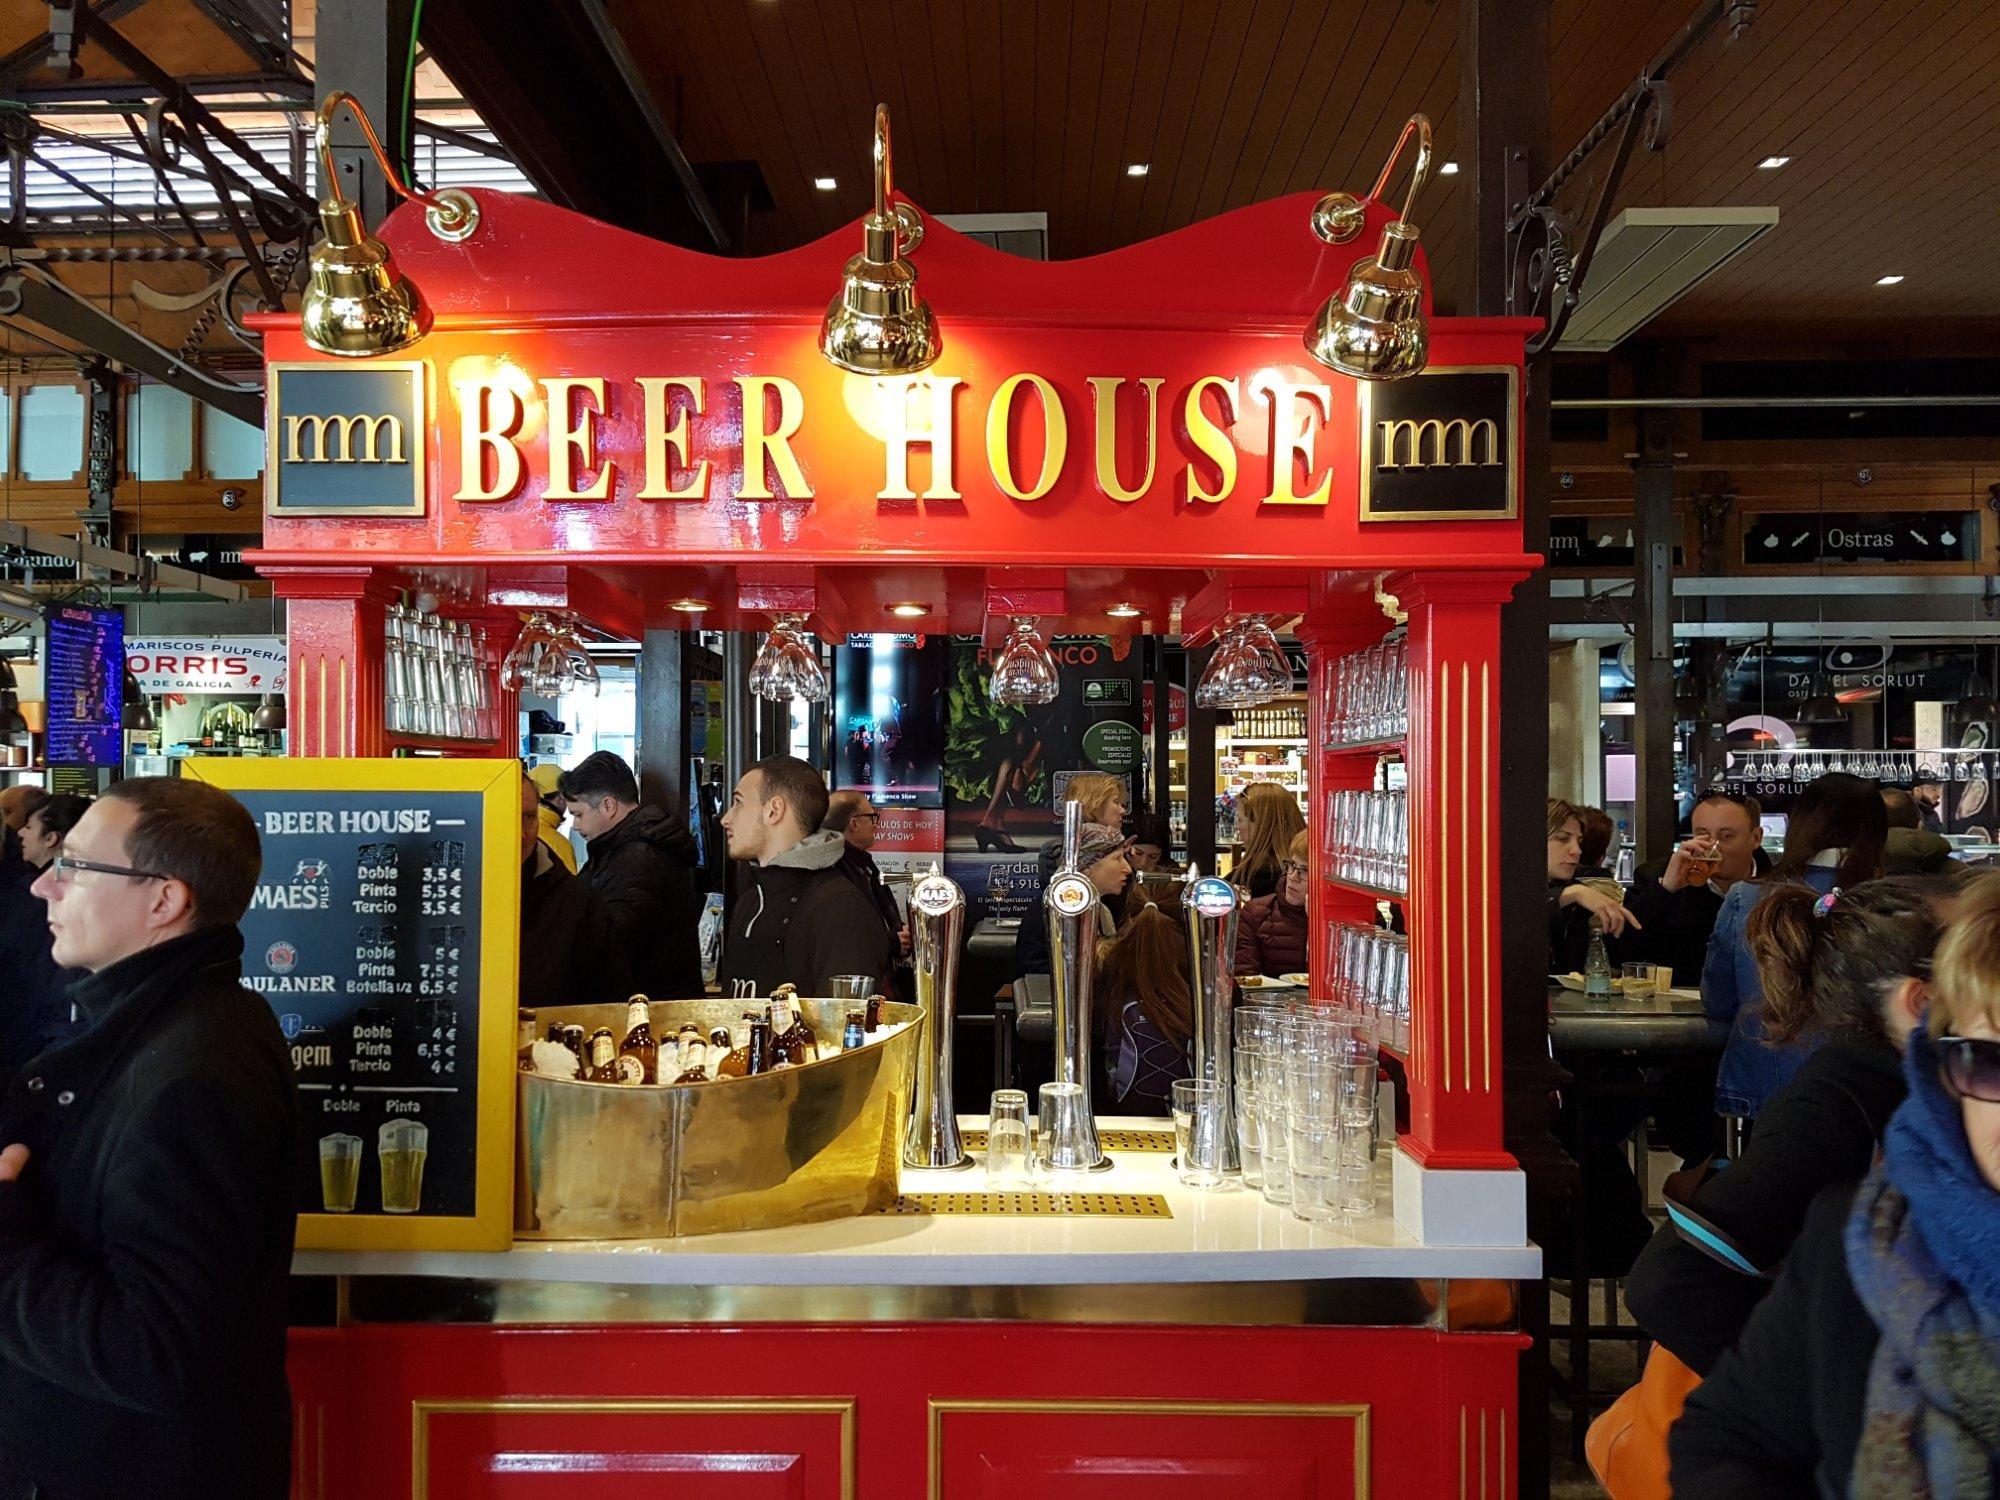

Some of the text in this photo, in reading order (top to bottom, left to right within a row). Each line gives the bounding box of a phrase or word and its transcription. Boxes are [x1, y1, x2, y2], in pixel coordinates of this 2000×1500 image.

[453, 372, 1334, 505] BEER HOUSE
[1828, 528, 1894, 548] Ostras
[977, 646, 1098, 666] FLNCO
[153, 679, 170, 687] DE
[176, 680, 232, 688] GALICIA
[1789, 674, 1926, 687] DAEL SORLUT
[1756, 783, 1809, 795] SORLU
[264, 809, 431, 835] BEER HOUSE
[903, 820, 914, 828] DE
[915, 821, 933, 829] HOY
[886, 832, 915, 840] SHOWS
[357, 866, 398, 880] Doble
[422, 867, 447, 882] 3,5
[250, 885, 318, 910] MAES
[320, 885, 330, 909] PILS
[359, 883, 397, 897] Pinta
[421, 885, 447, 899] 5,5
[352, 901, 397, 914] Tercio
[421, 901, 447, 916] 3,5
[356, 947, 395, 960] Doble
[435, 948, 445, 960] 5
[358, 963, 395, 976] Pinta
[420, 964, 445, 979] 7,5
[346, 980, 394, 993] Botella
[419, 980, 444, 994] 6,5
[353, 1026, 393, 1039] Doble
[432, 1027, 442, 1040] 4
[356, 1042, 392, 1055] Pinta
[417, 1044, 442, 1058] 6,5
[350, 1060, 392, 1072] Tercio
[431, 1060, 441, 1074] 4
[323, 1099, 421, 1113] Doble Pinta
